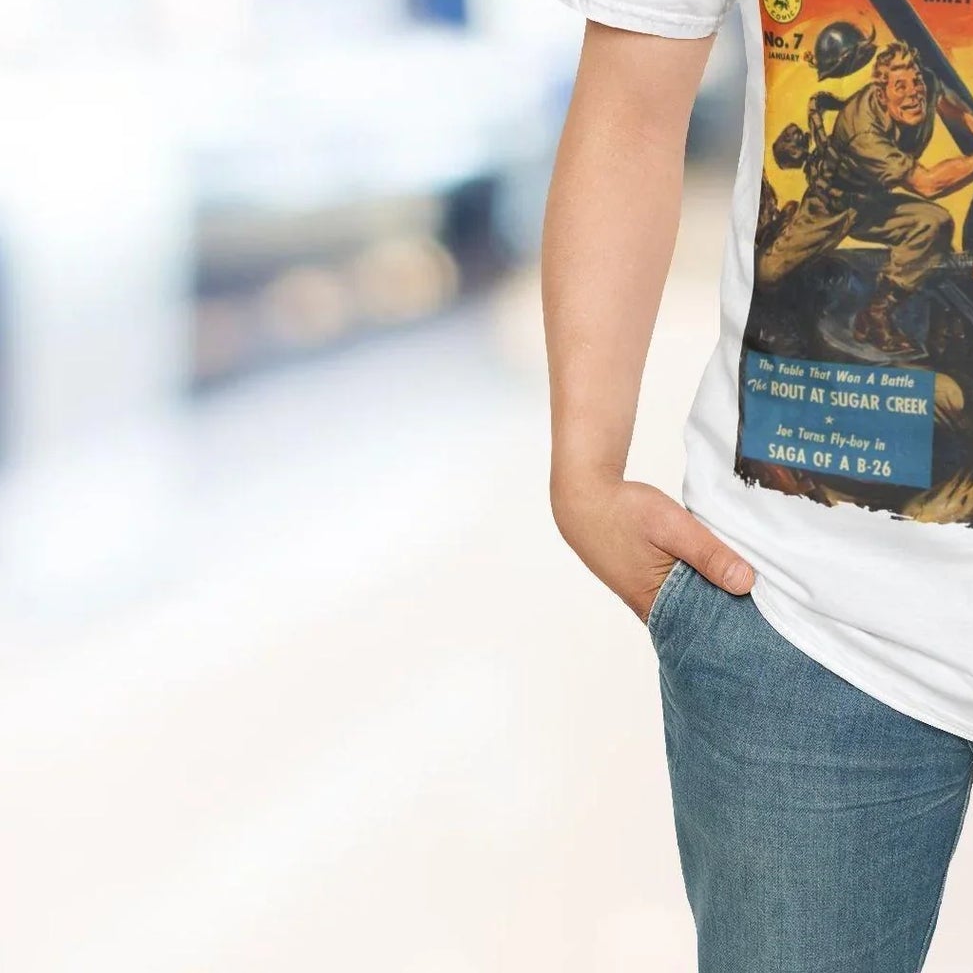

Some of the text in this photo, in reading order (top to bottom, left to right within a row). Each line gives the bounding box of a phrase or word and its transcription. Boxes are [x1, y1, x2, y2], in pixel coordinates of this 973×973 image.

[763, 31, 804, 49] No. 7
[768, 51, 800, 62] JANUARY
[759, 359, 915, 388] The Fable That Won A Battle
[747, 379, 928, 416] The ROUT AT SUGAR CREEK
[776, 424, 885, 451] Joe Turns Fly-boy in
[768, 443, 891, 477] SAGA OF A B-26
